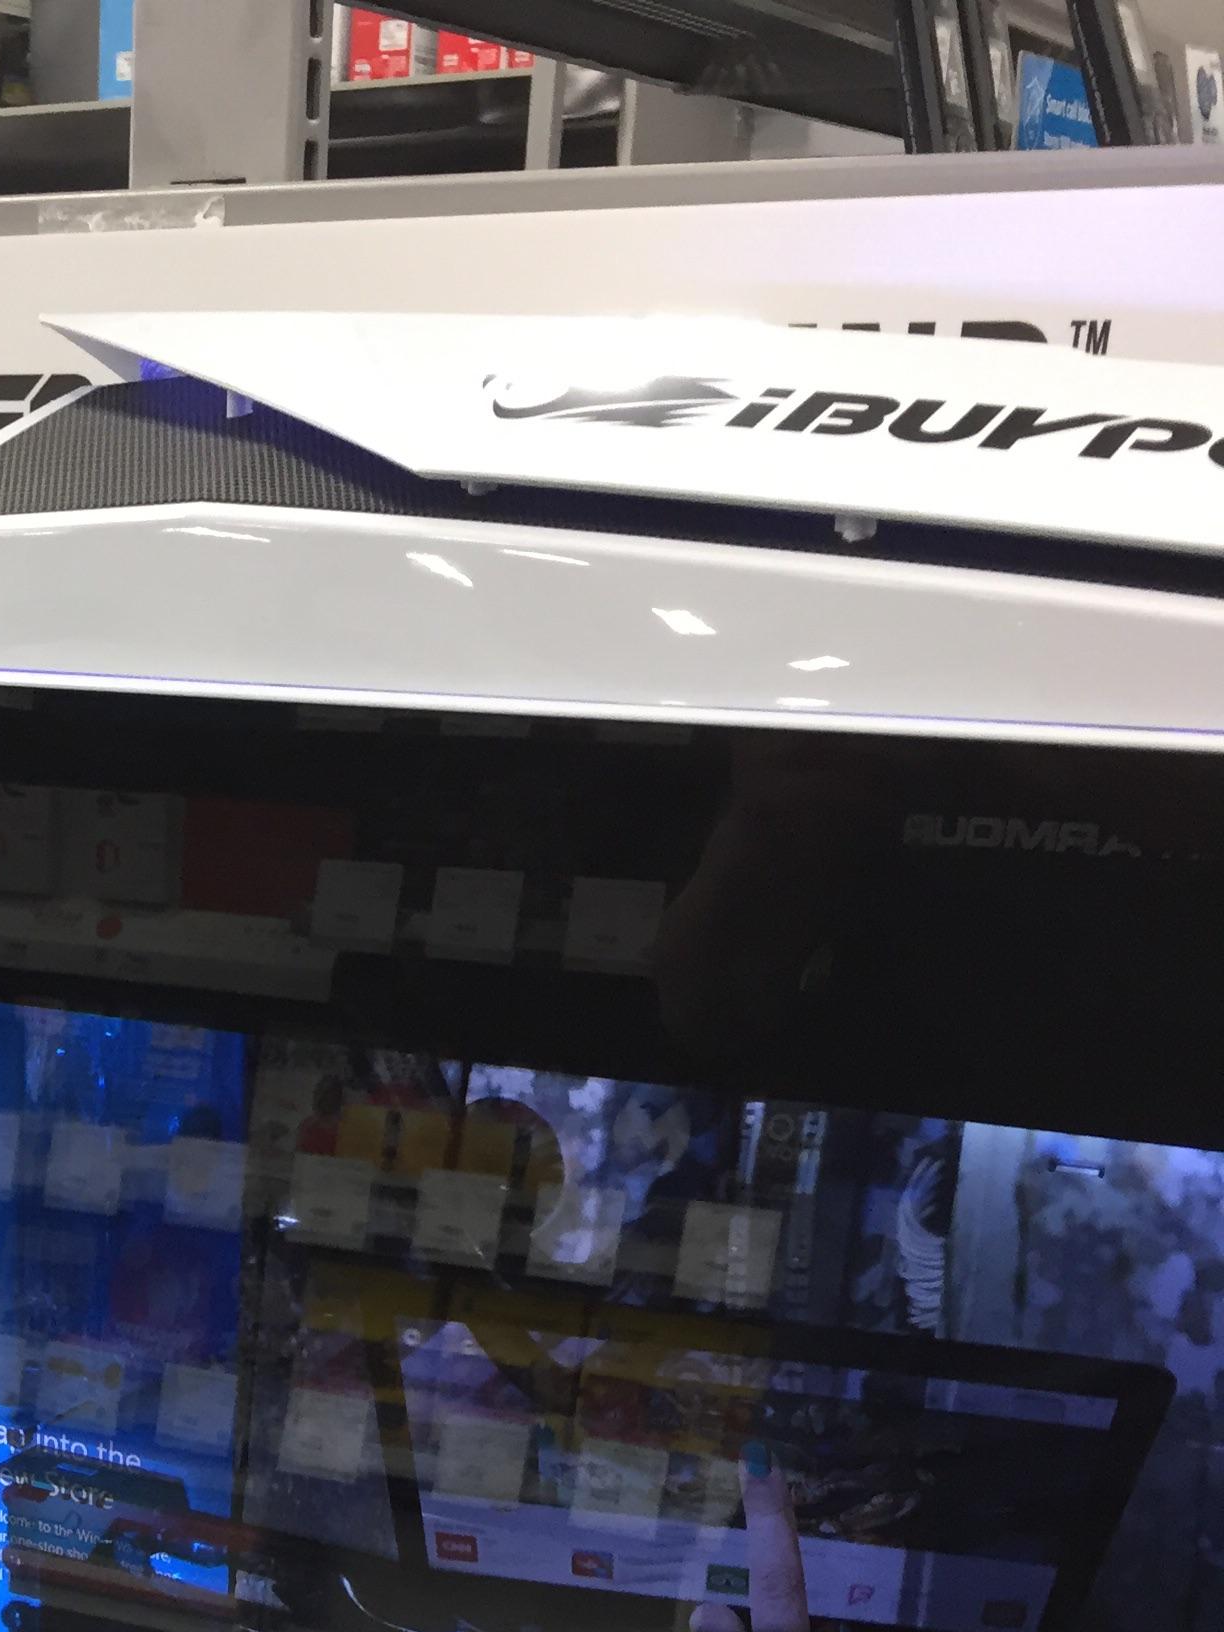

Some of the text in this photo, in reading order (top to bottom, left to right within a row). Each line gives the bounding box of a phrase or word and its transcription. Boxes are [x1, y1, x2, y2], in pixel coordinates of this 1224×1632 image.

[724, 388, 1224, 470] iBUYP
[35, 1424, 88, 1456] into
[96, 1440, 142, 1468] the
[47, 1470, 114, 1510] Store
